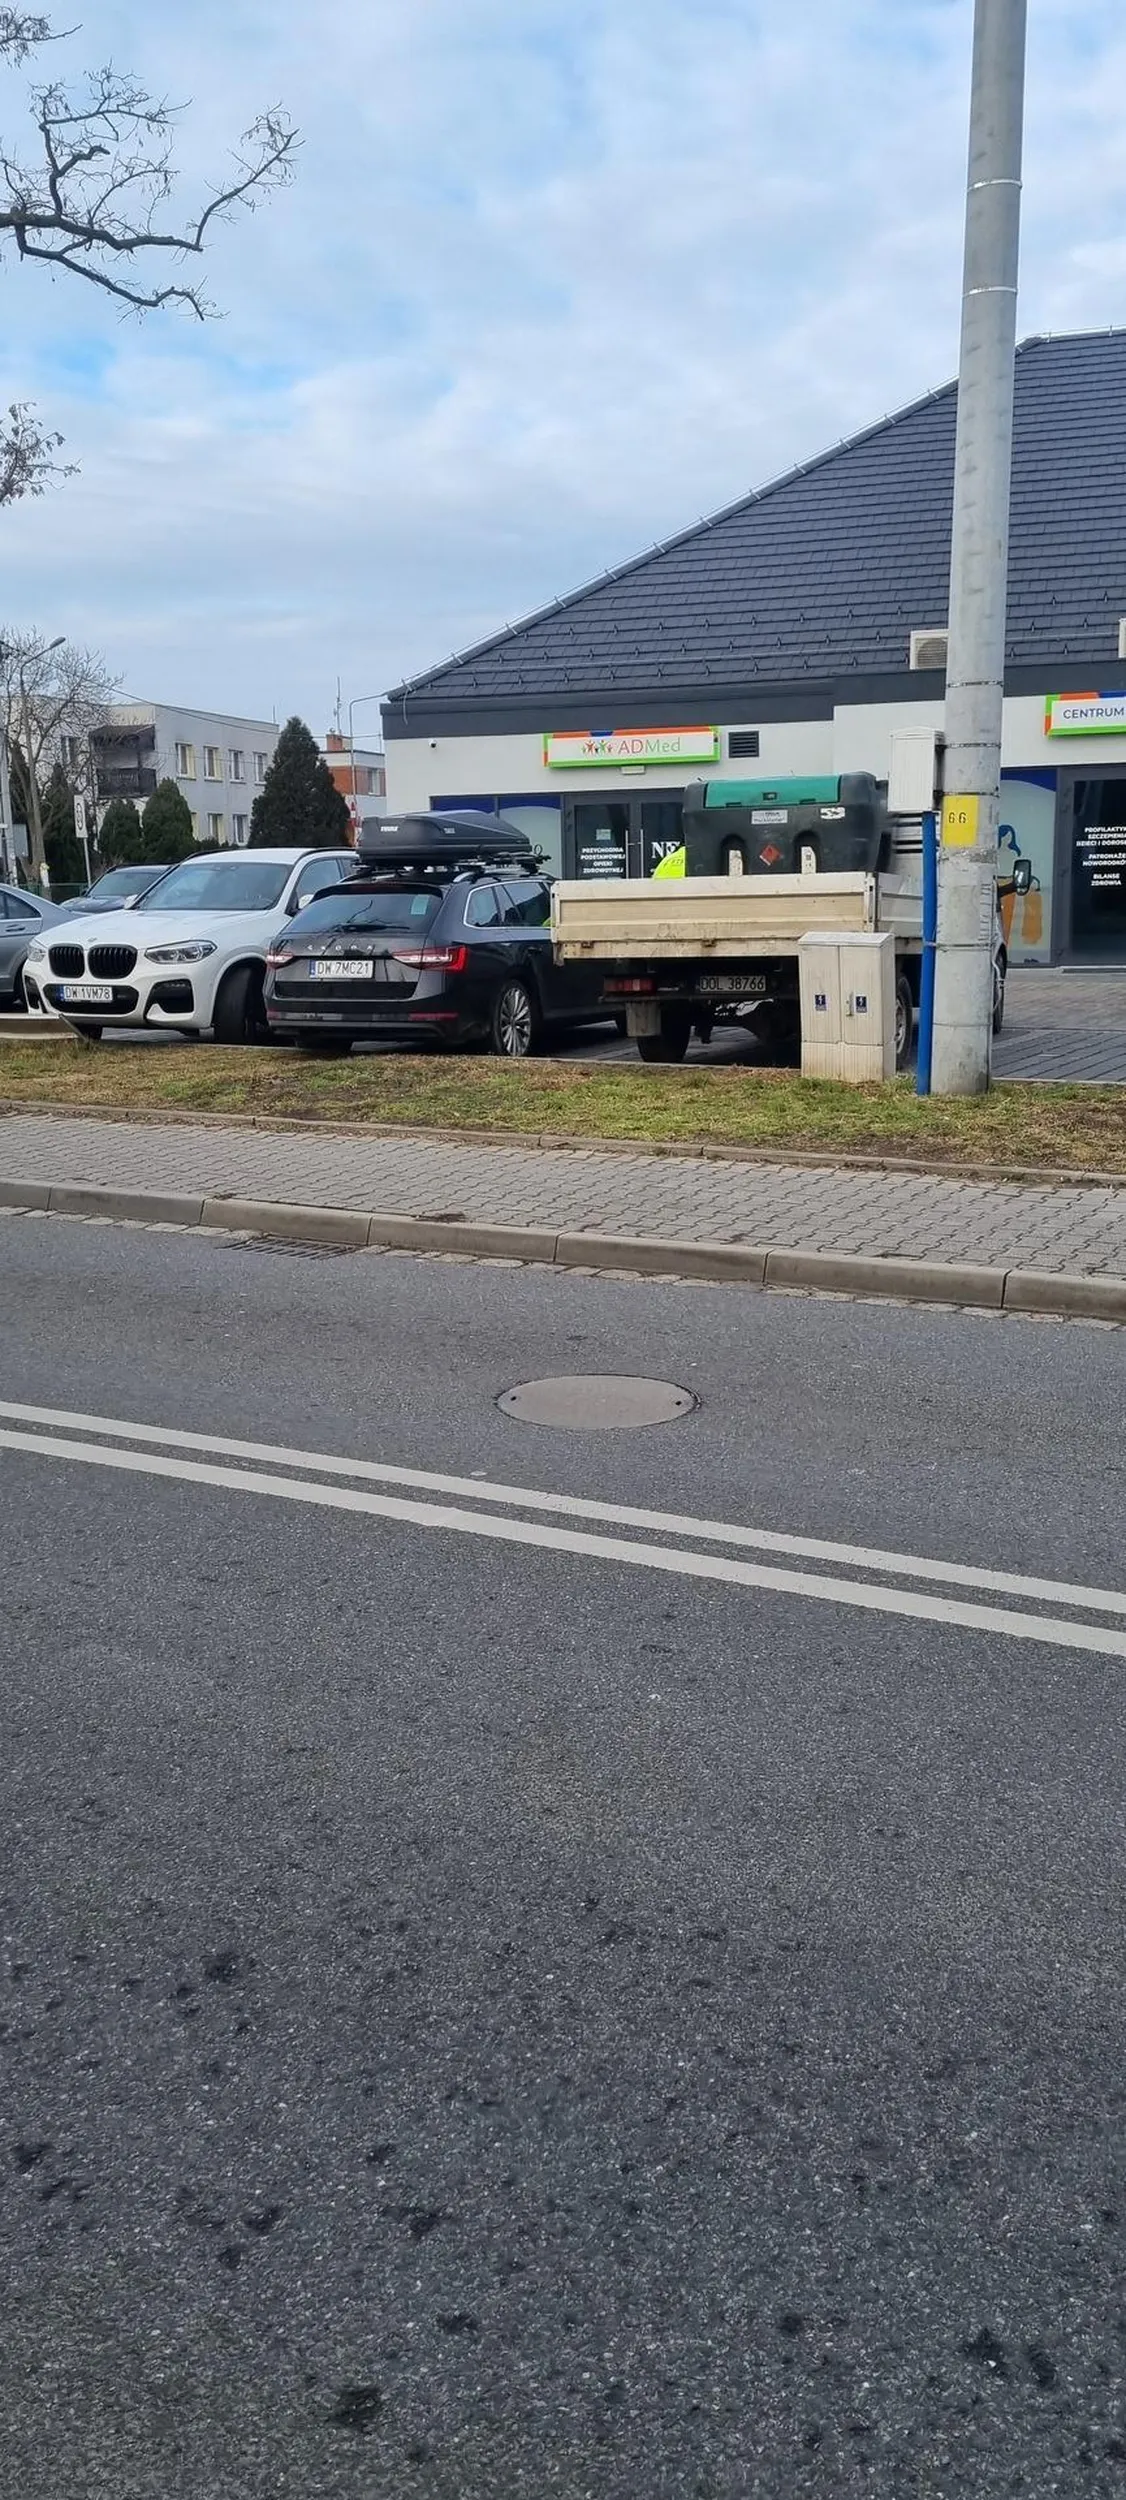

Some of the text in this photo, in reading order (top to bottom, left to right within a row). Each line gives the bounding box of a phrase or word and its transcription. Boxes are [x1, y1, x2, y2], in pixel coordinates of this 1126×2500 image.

[1062, 707, 1125, 719] CENTRUM
[617, 737, 681, 755] ADMed
[317, 961, 369, 975] DW 7MC21
[728, 977, 764, 990] 38766
[65, 986, 110, 1000] DW 1VM78
